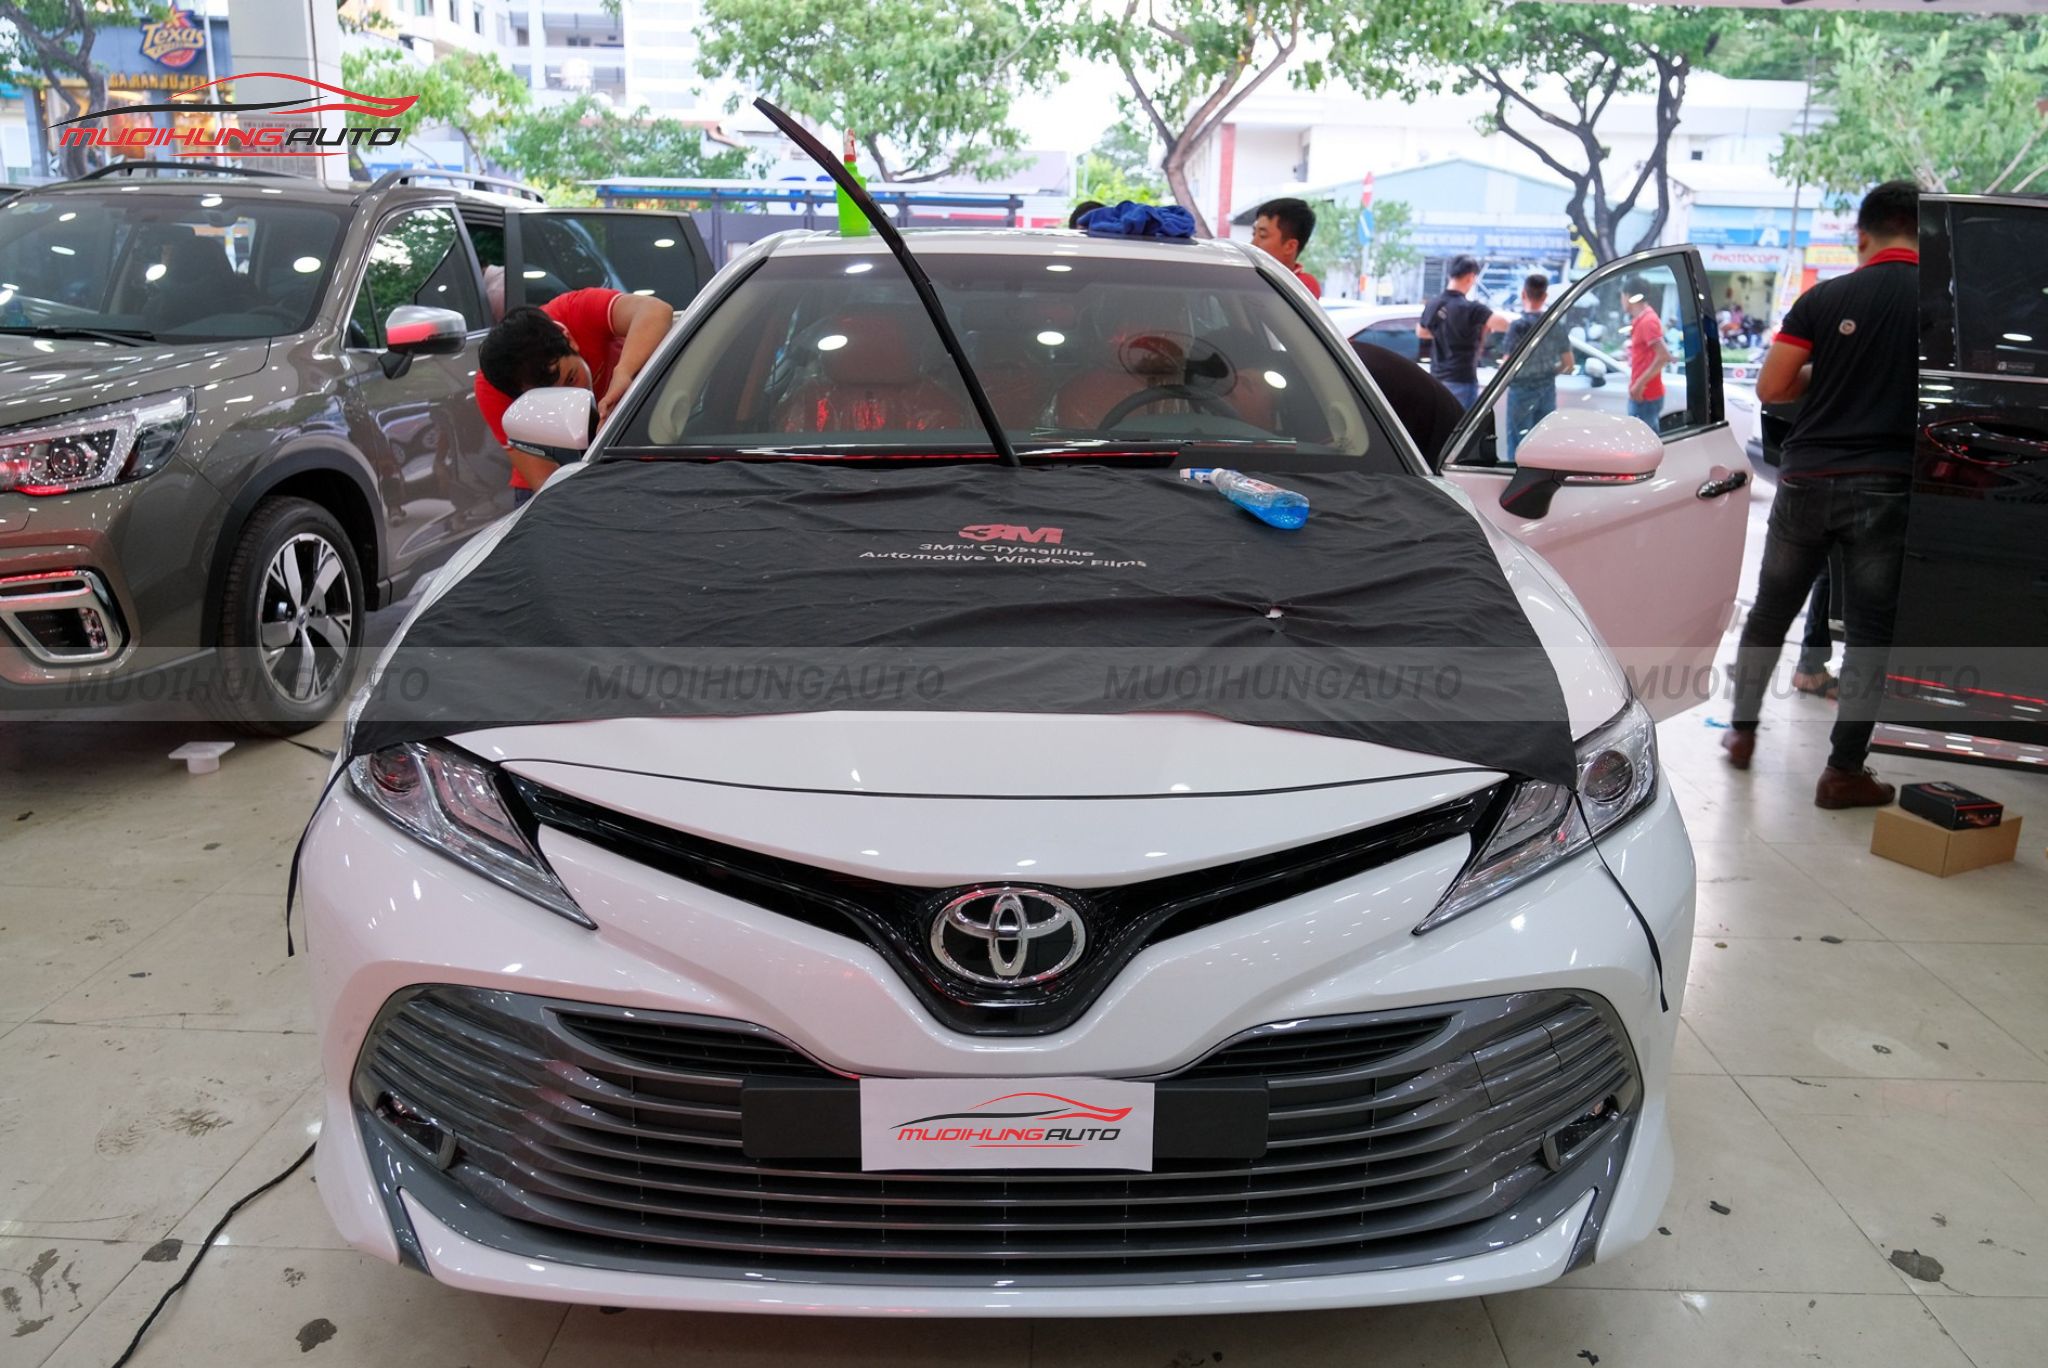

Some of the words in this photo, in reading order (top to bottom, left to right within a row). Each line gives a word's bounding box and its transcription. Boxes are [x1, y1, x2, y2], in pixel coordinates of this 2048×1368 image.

[142, 22, 206, 51] Texas
[1712, 252, 1782, 265] PHOTOCOPY
[958, 524, 1064, 544] 3M
[979, 545, 1095, 557] Crystalline
[859, 551, 987, 561] Automotive
[993, 555, 1085, 566] Window
[1090, 559, 1147, 568] Films
[897, 1128, 1122, 1141] MUOIHUNGAUTO
